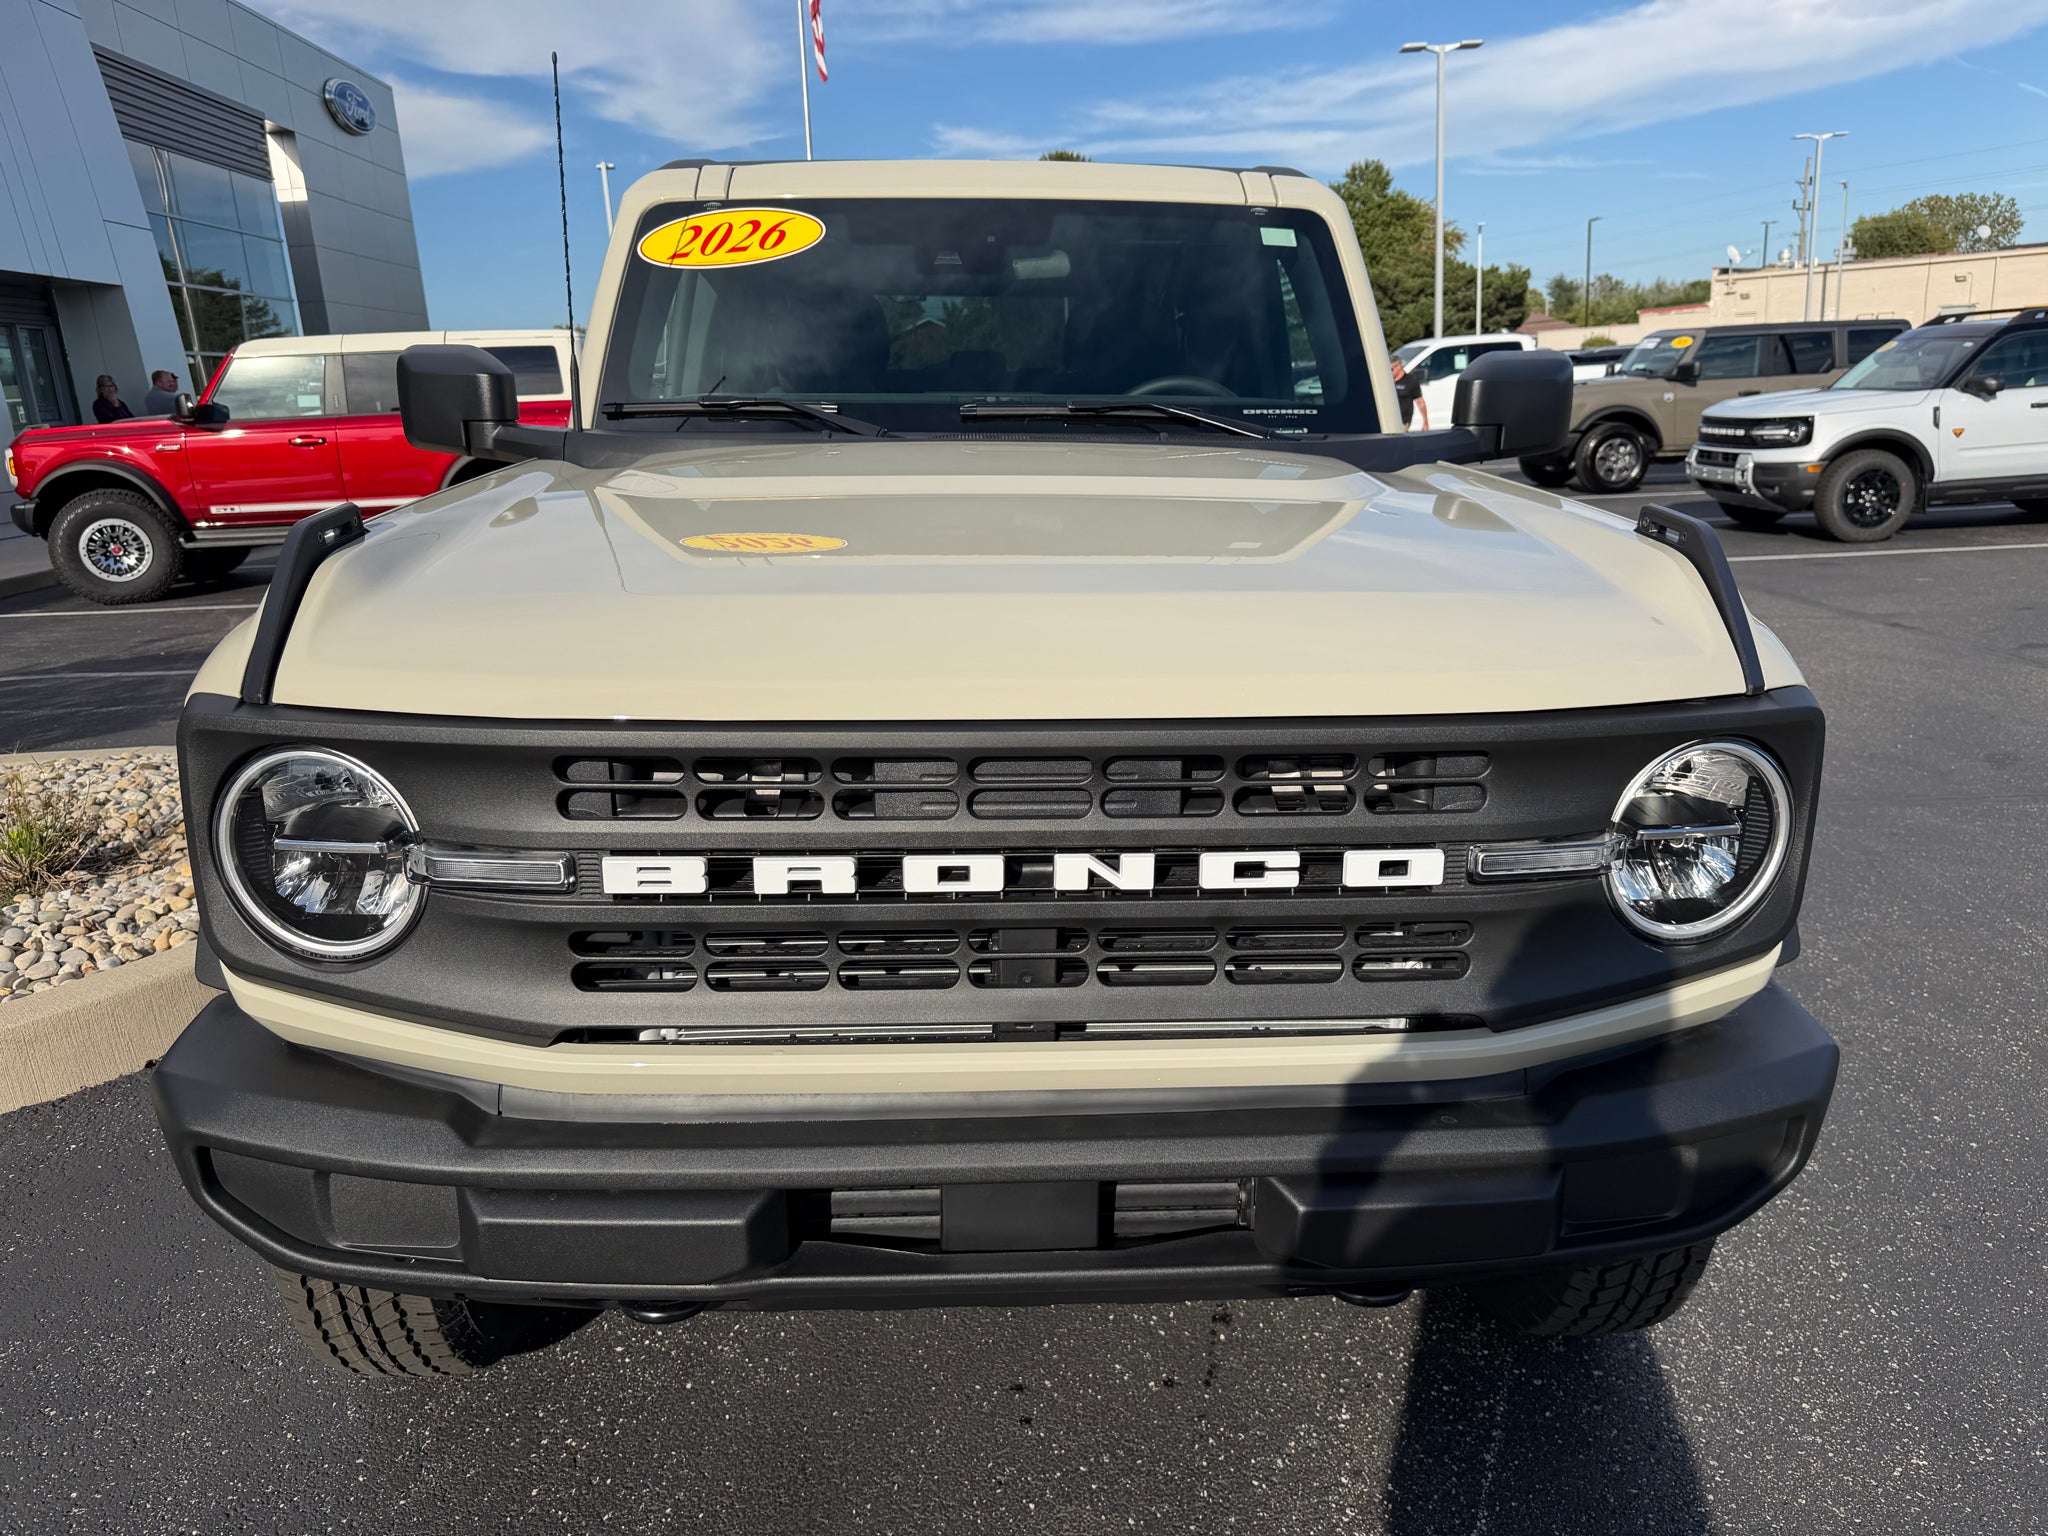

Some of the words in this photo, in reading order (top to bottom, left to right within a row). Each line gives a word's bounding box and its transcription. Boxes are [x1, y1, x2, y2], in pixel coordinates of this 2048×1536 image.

[345, 89, 370, 127] Ford
[667, 217, 796, 260] 2026
[602, 849, 1446, 895] BRONCO
